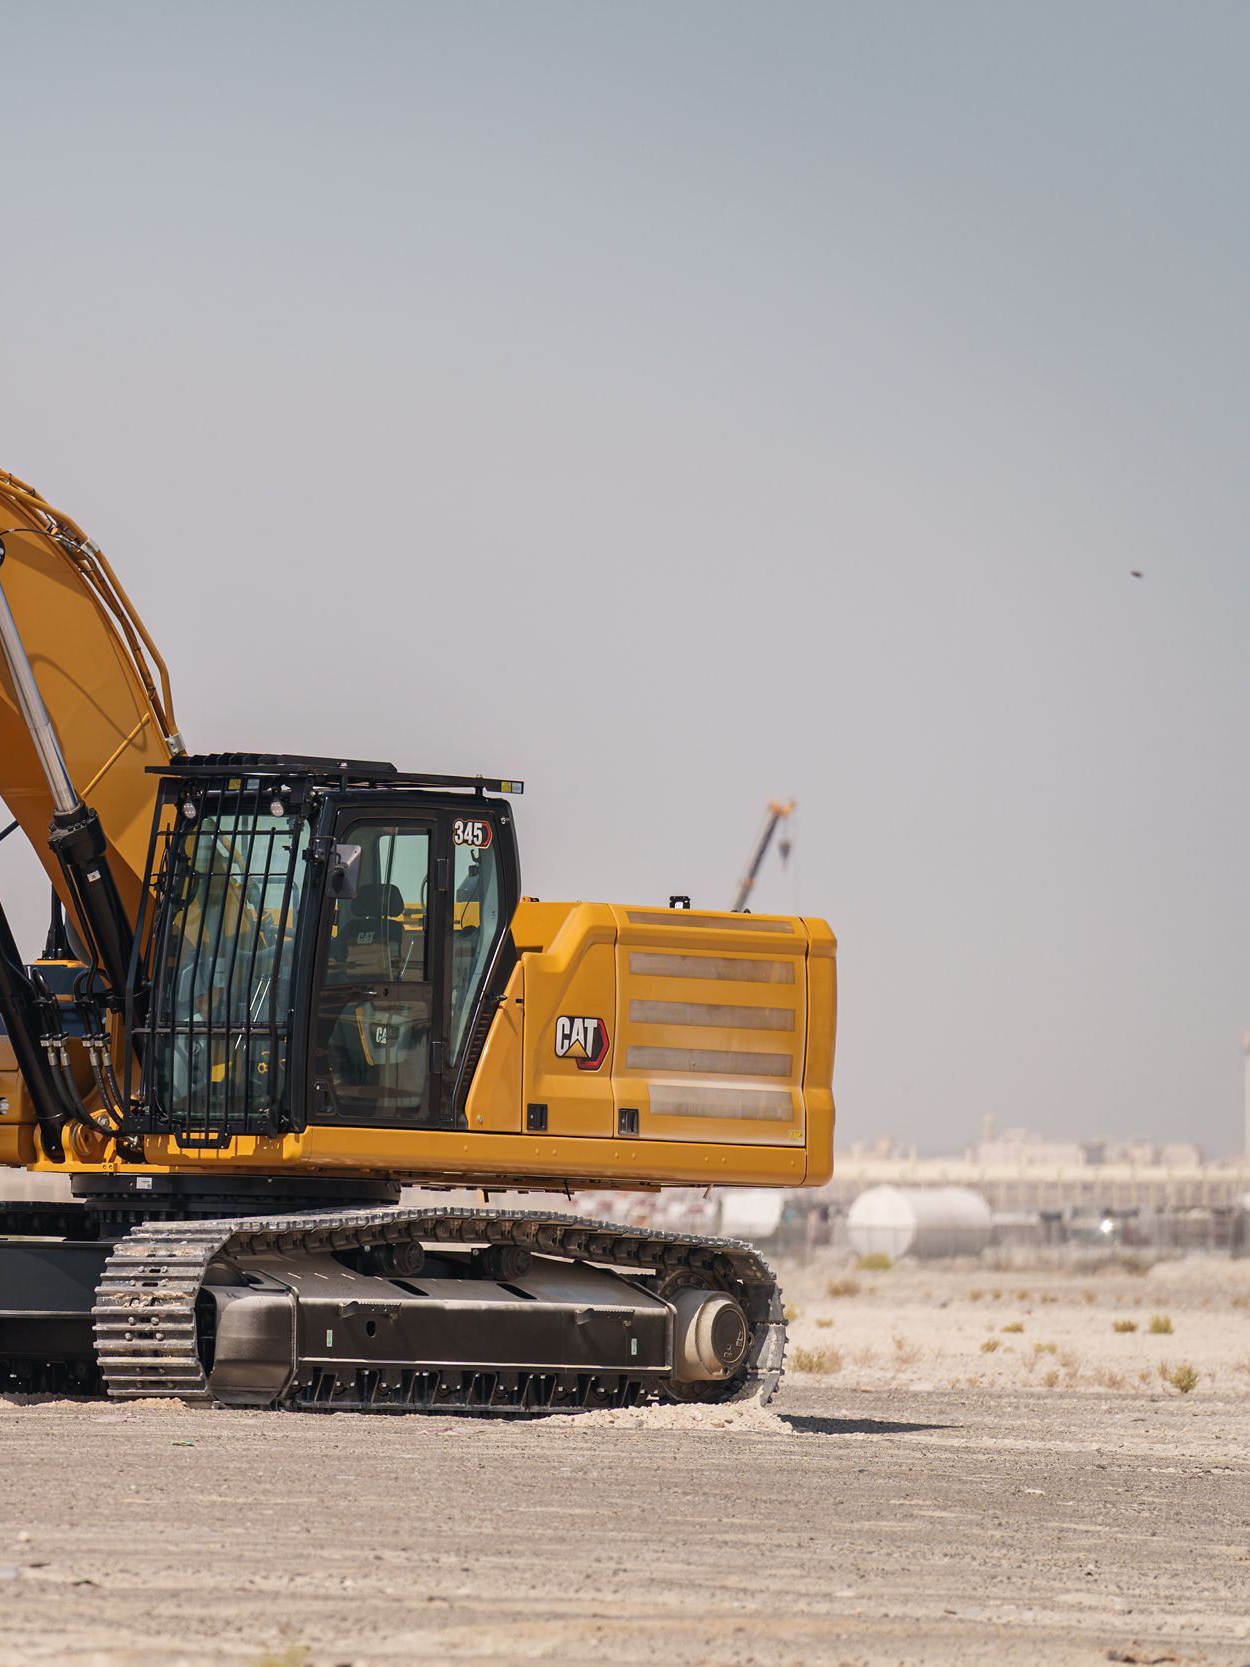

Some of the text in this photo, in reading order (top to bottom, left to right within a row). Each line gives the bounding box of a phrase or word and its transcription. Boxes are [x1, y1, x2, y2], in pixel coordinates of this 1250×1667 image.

[454, 820, 483, 846] 345
[357, 931, 375, 945] CAT
[376, 1026, 387, 1044] CA
[555, 1016, 598, 1058] CAT
